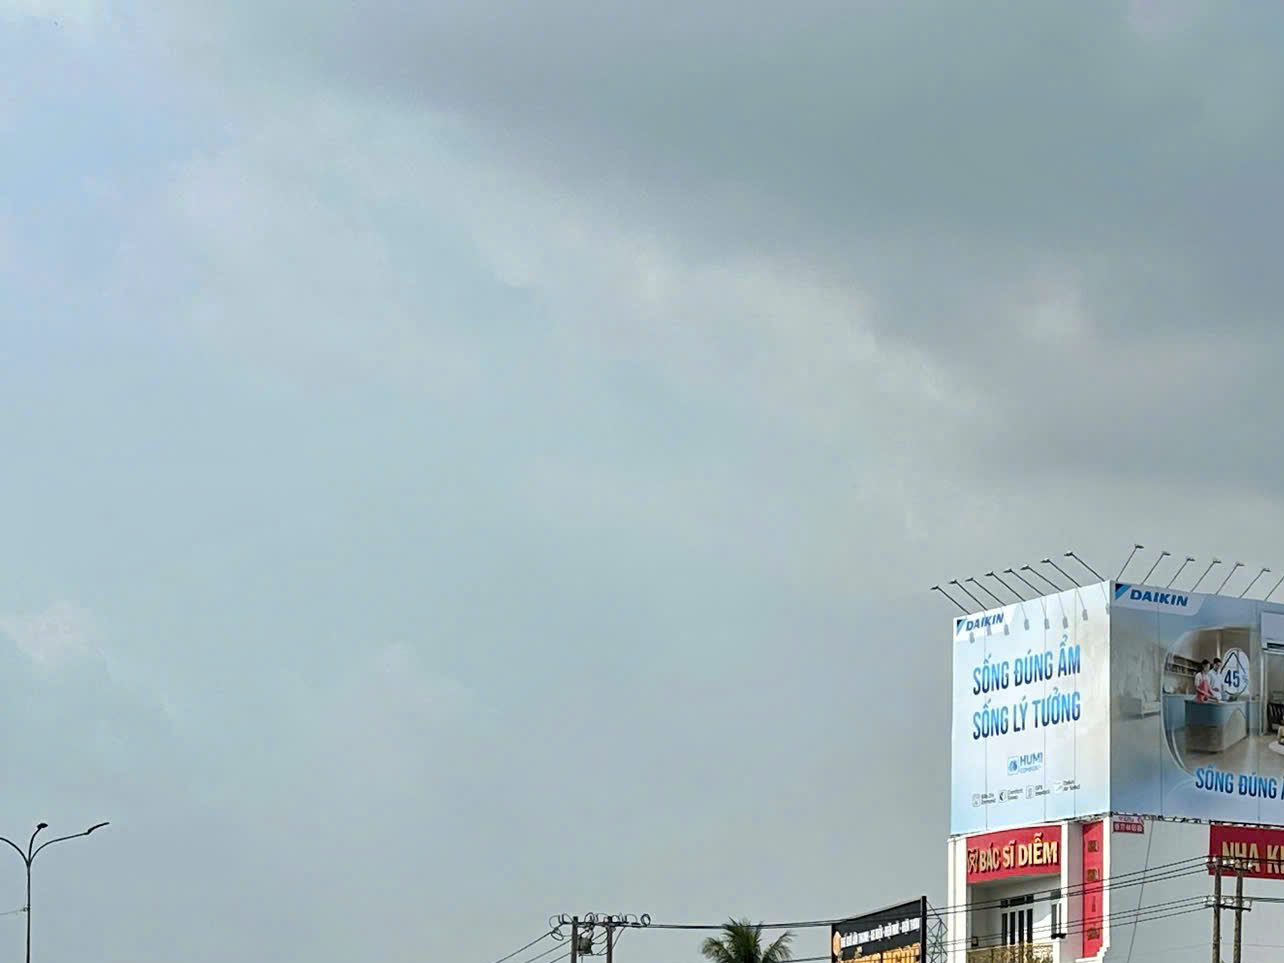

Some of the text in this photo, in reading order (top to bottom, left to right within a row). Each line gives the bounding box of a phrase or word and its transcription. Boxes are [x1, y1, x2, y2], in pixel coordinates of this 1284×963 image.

[1130, 589, 1188, 607] DAIKIN
[966, 612, 1004, 631] DAIKIN
[973, 634, 1081, 695] SỐNG ĐÚNG ẨM
[973, 686, 1081, 740] SỐNG LÝ TƯỞNG
[1238, 772, 1277, 799] ĐÚNG
[979, 832, 1058, 871] BÁC SĨ DIỄM
[1222, 841, 1261, 873] NHA
